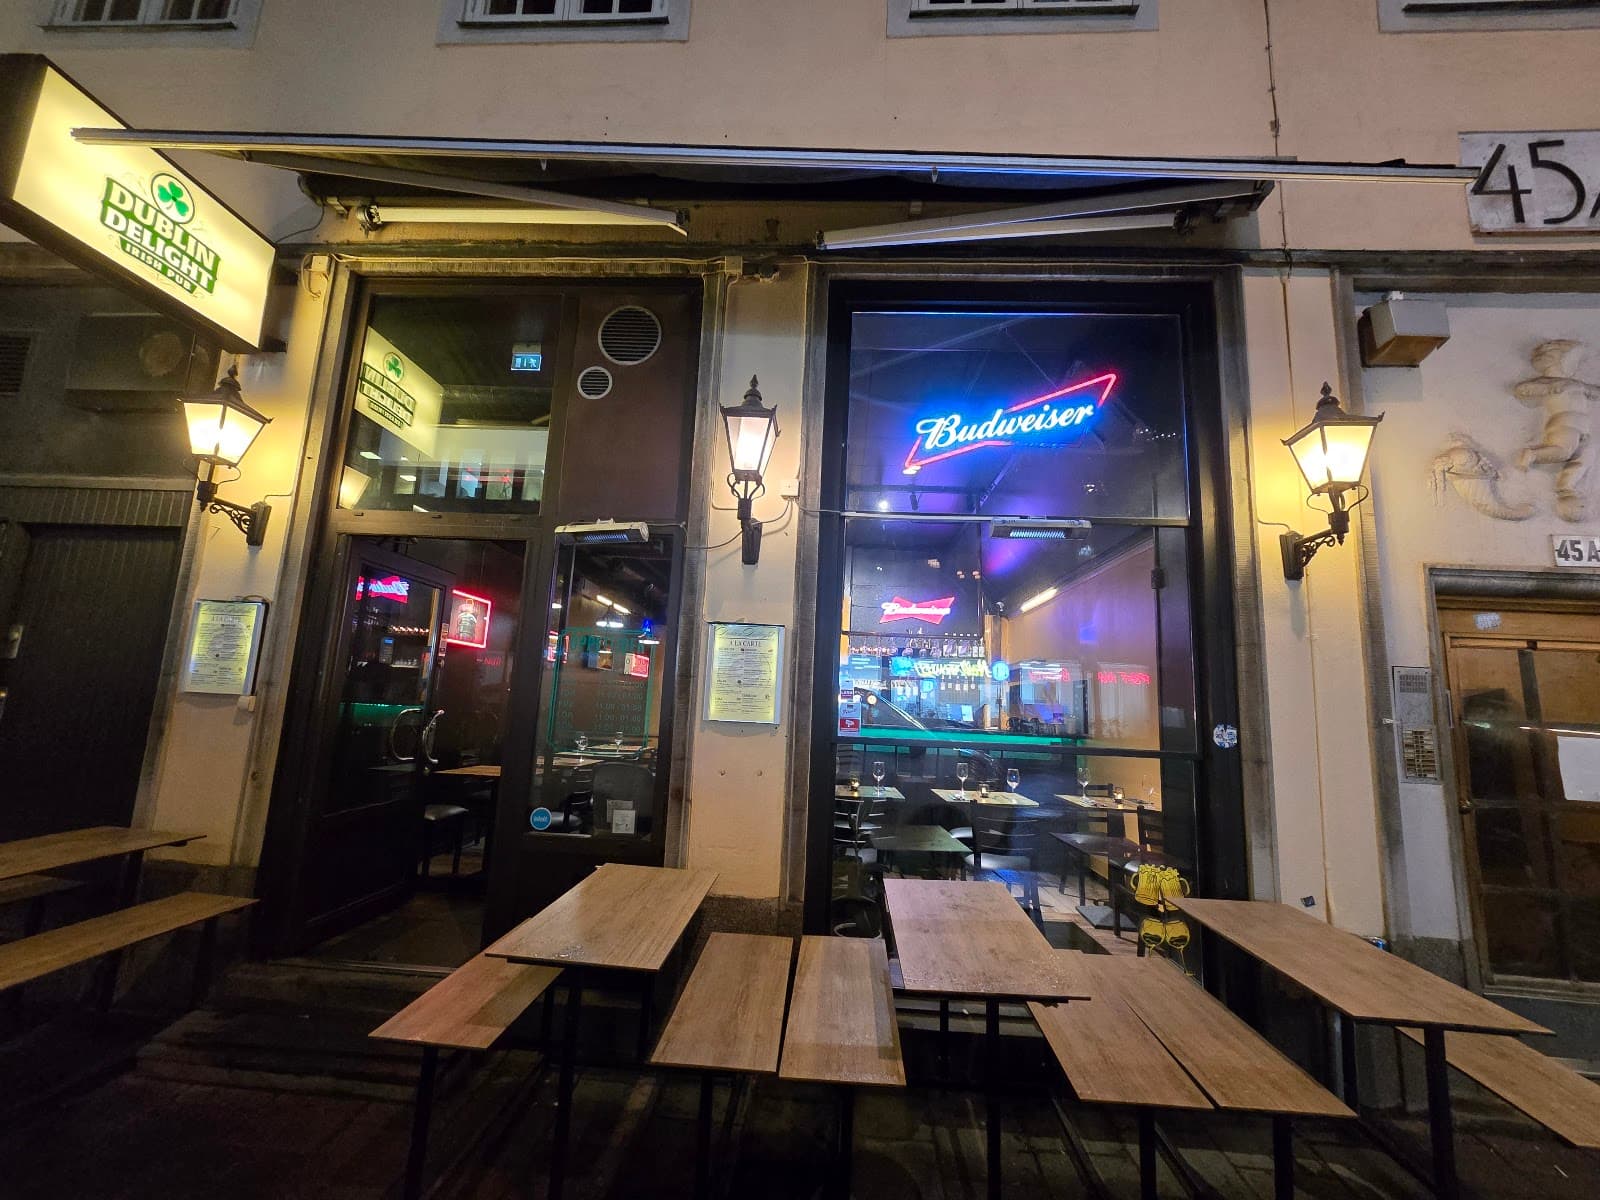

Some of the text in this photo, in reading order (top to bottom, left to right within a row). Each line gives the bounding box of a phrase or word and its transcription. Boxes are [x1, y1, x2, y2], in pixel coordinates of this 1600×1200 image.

[1471, 139, 1600, 224] 45
[104, 205, 213, 288] DELIGHT
[108, 179, 216, 270] DUBLIN
[125, 242, 192, 290] IRISH PUB
[916, 404, 1094, 449] Budweiser
